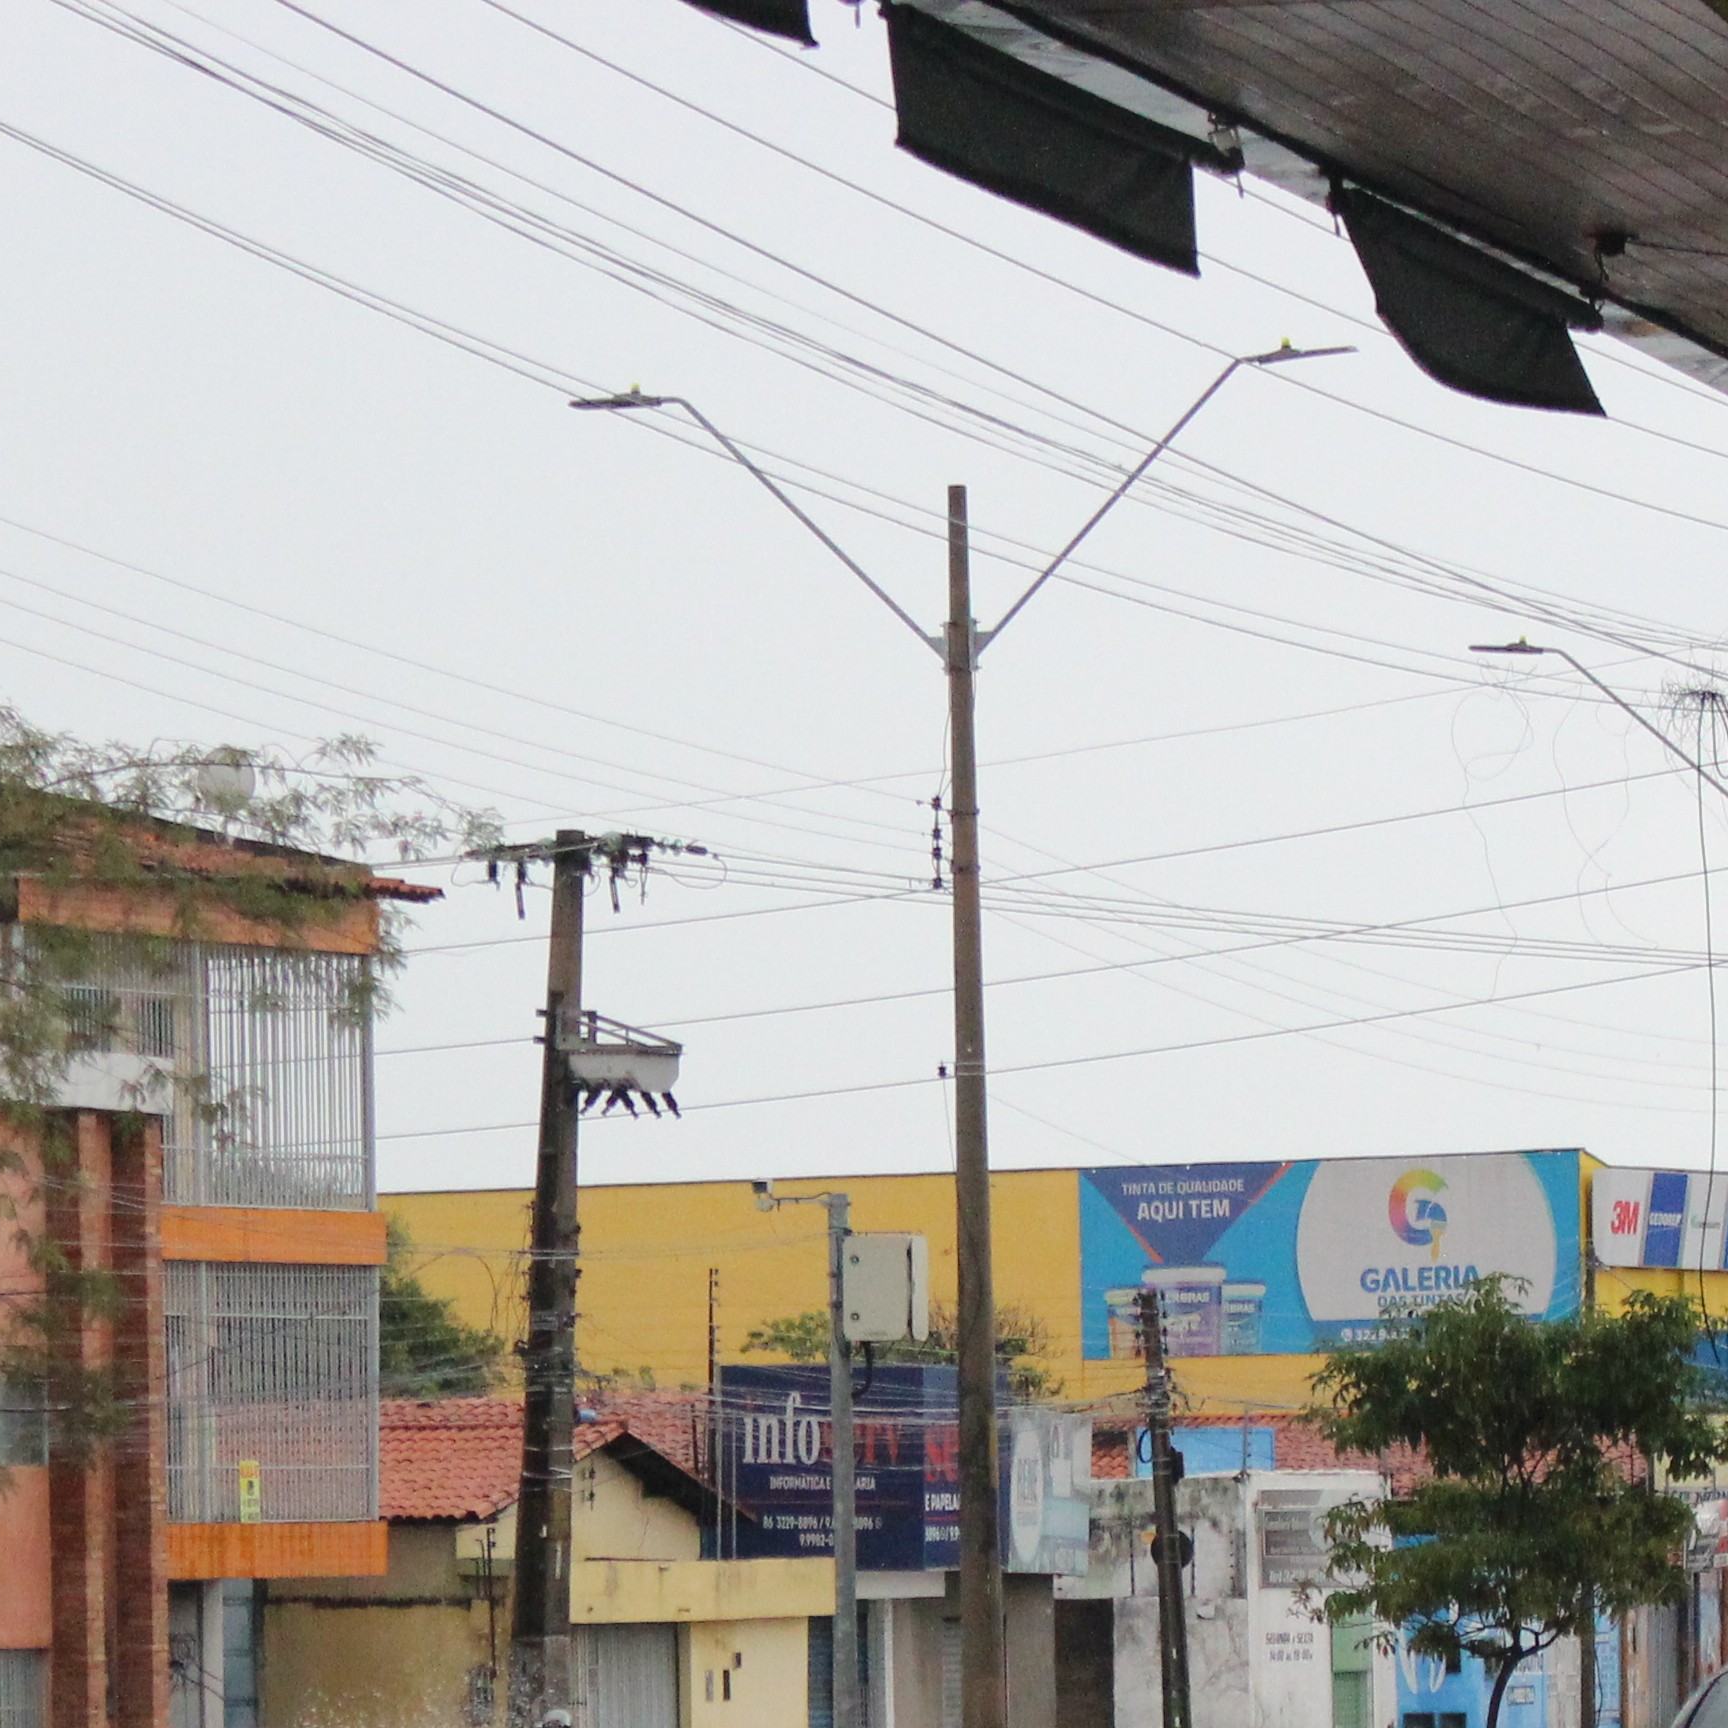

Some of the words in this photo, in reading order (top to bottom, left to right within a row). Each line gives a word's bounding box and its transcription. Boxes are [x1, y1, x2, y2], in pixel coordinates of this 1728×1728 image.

[1122, 1183, 1155, 1196] TINTA
[1159, 1182, 1173, 1194] DE
[1177, 1179, 1244, 1195] QUALIDADE
[1137, 1200, 1183, 1222] AQUI
[1190, 1199, 1230, 1219] TEM
[1611, 1200, 1641, 1236] 3M
[1360, 1264, 1480, 1293] GALERIA
[1378, 1294, 1407, 1308] DAS
